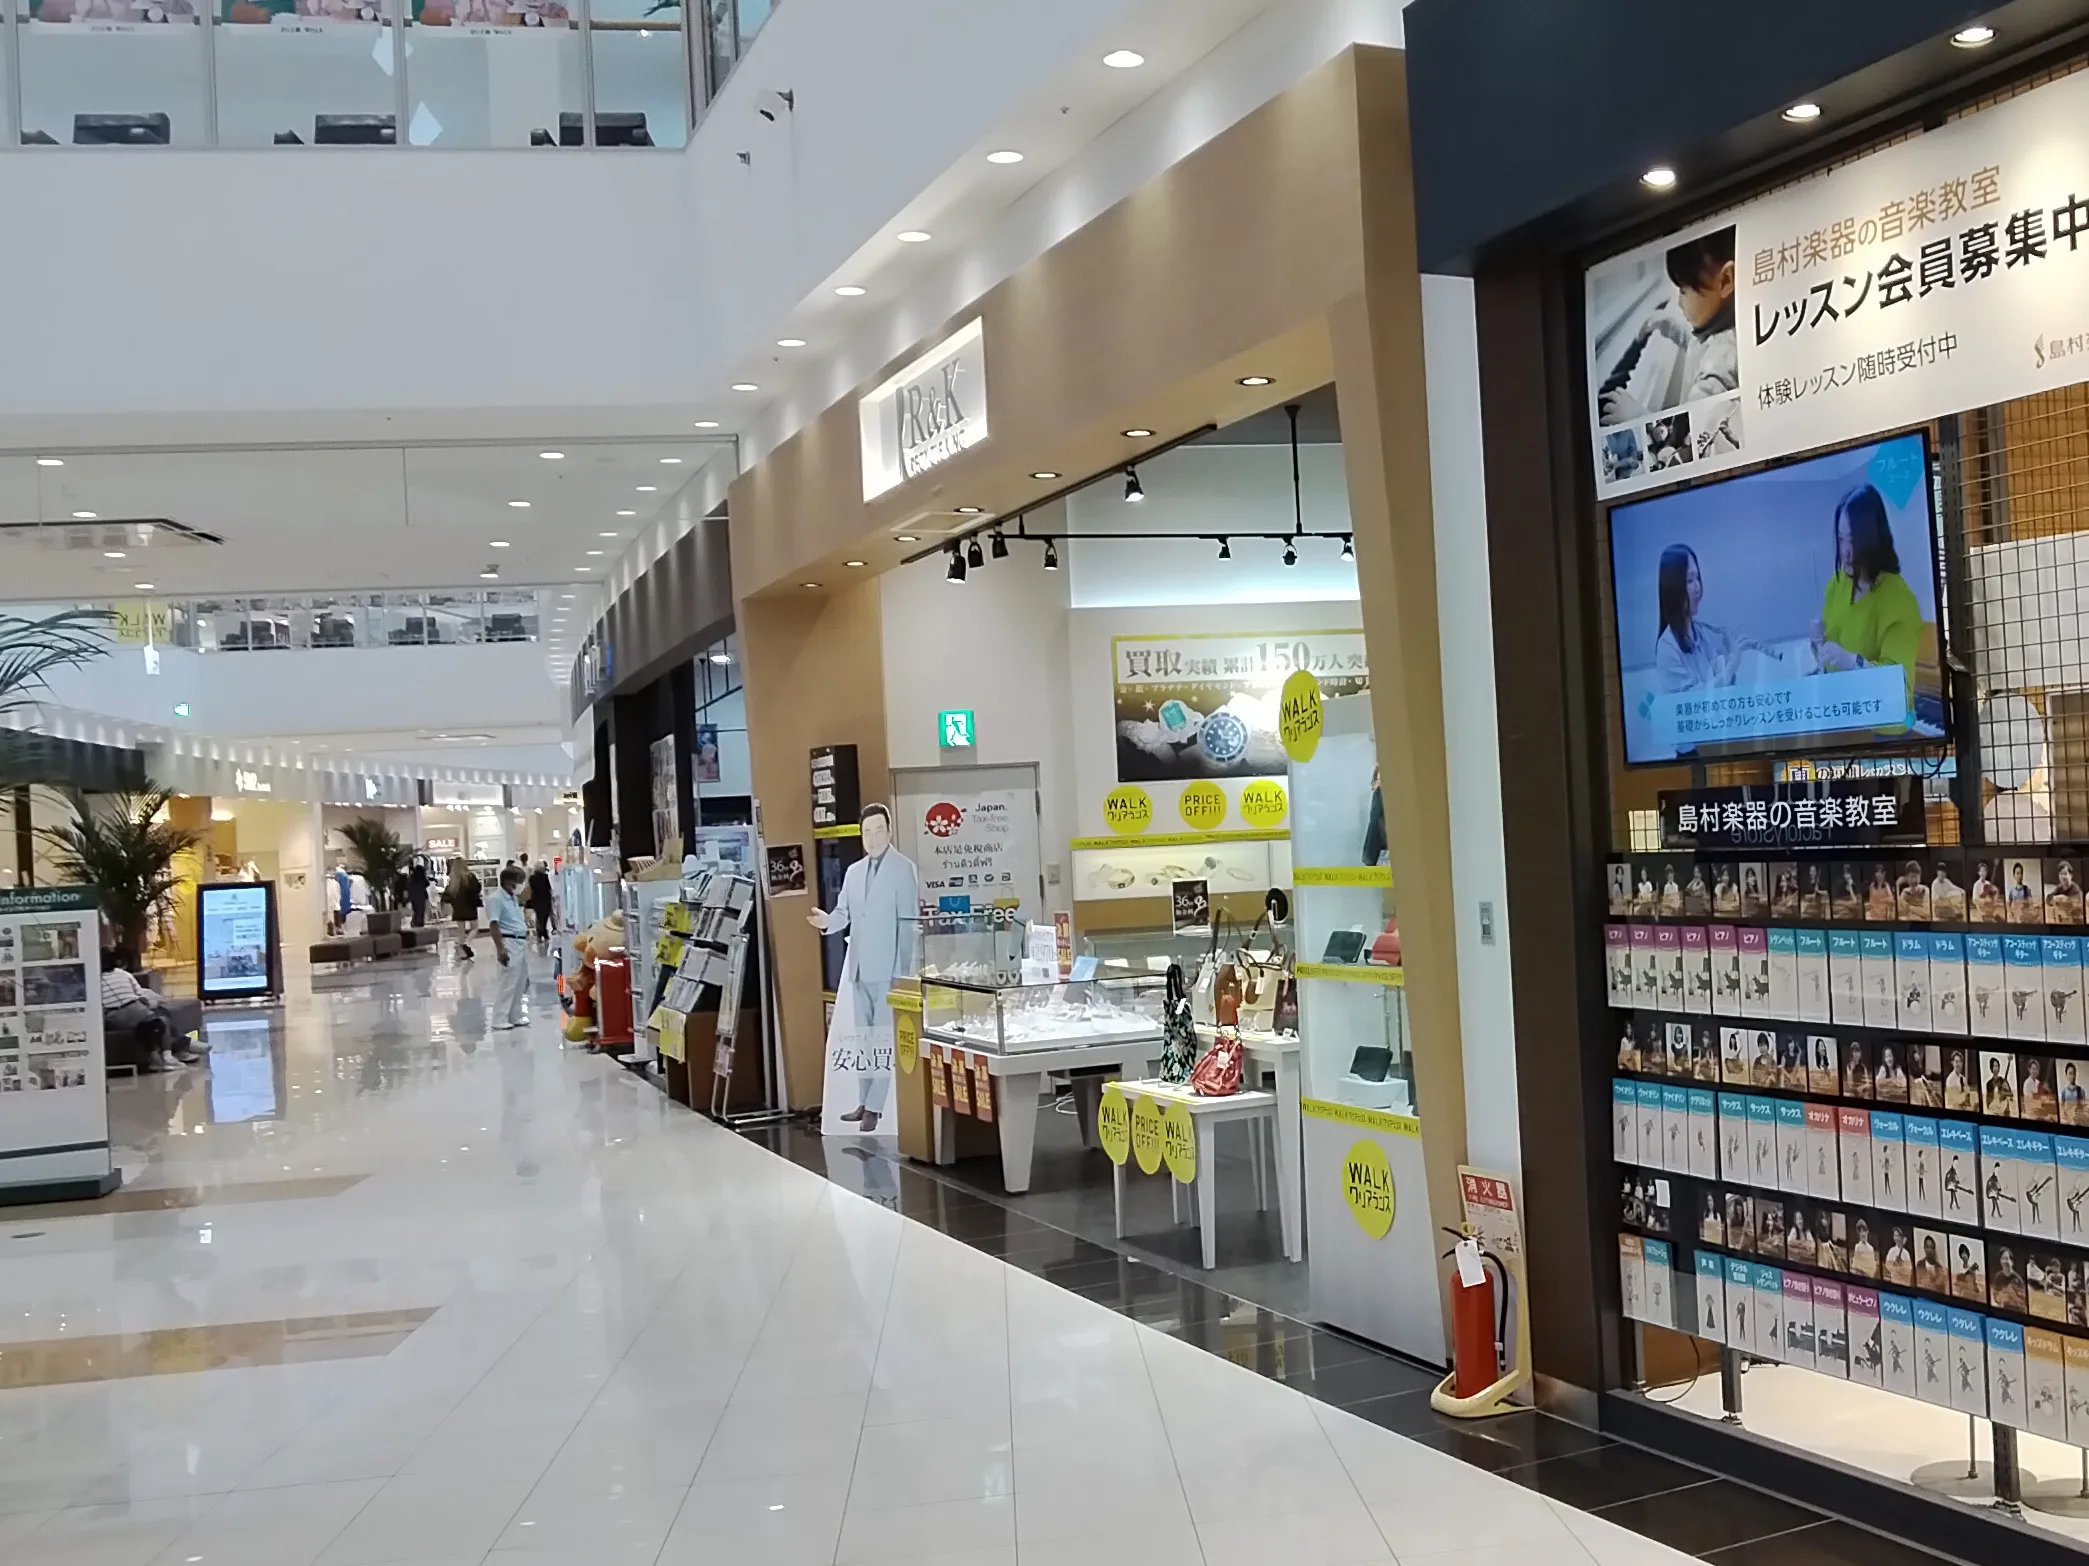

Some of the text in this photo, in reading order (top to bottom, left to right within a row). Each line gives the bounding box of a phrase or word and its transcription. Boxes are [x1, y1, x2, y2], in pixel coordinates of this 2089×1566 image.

[1752, 165, 2001, 286] 島村楽器の音楽教室
[1754, 193, 2089, 347] レッスン会員募集中
[2050, 332, 2089, 361] 島村
[1758, 331, 1958, 411] 体験レッスン随時受付中
[1876, 451, 1919, 473] フルート
[1281, 688, 1317, 723] WALK
[1675, 690, 1792, 717] 楽器が初めての方も安心です
[1677, 699, 1882, 733] 基礎からしっかりレッスンを受けることも可能です
[1107, 797, 1148, 810] WALK
[1184, 794, 1221, 805] PRICE
[1243, 790, 1283, 804] WALK
[975, 803, 1008, 813] Japan.
[1185, 806, 1221, 817] OFF!!!
[1678, 793, 1899, 834] 島村楽器の音楽教室
[985, 824, 1009, 834] Shop
[428, 839, 456, 848] SALE
[926, 881, 946, 889] VISA
[0, 890, 80, 906] nformation
[1800, 936, 1822, 947] フルート
[1832, 937, 1856, 948] フルート
[1864, 937, 1888, 948] フルート
[1902, 938, 1921, 950] ドラム
[1935, 939, 1956, 950] ドラム
[832, 1047, 897, 1072] 安心買
[1721, 1098, 1742, 1111] サックス
[1750, 1103, 1772, 1115] サックス
[1780, 1106, 1802, 1118] サックス
[1101, 1106, 1128, 1126] WALK
[1808, 1110, 1831, 1123] オカリナ
[1841, 1113, 1865, 1127] オカリナ
[1135, 1114, 1159, 1137] PRICE
[1165, 1120, 1194, 1144] WALK
[1349, 1161, 1390, 1193] WALK
[1884, 1300, 1907, 1315] ウクレレ
[1918, 1308, 1942, 1323] ウクレレ
[1952, 1316, 1977, 1331] ウクレレ
[1992, 1326, 2018, 1342] ウクレレ
